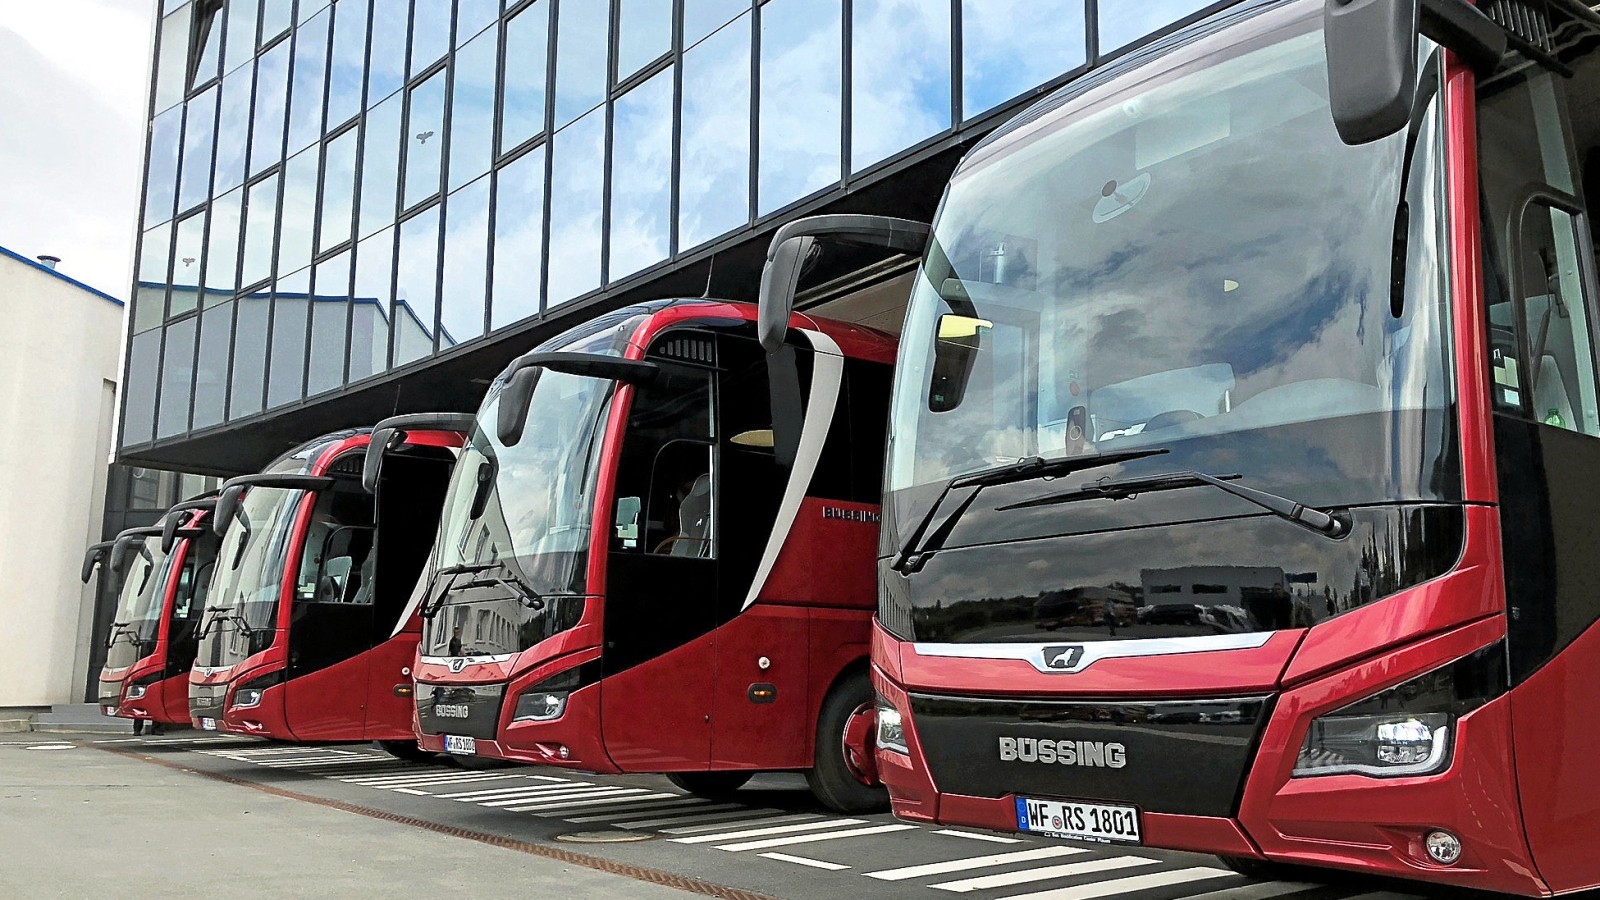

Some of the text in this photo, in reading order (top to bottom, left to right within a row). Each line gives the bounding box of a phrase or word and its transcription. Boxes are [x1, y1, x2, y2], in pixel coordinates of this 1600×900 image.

[999, 737, 1126, 768] BÜSSING
[1028, 803, 1137, 836] WF RS 1801
